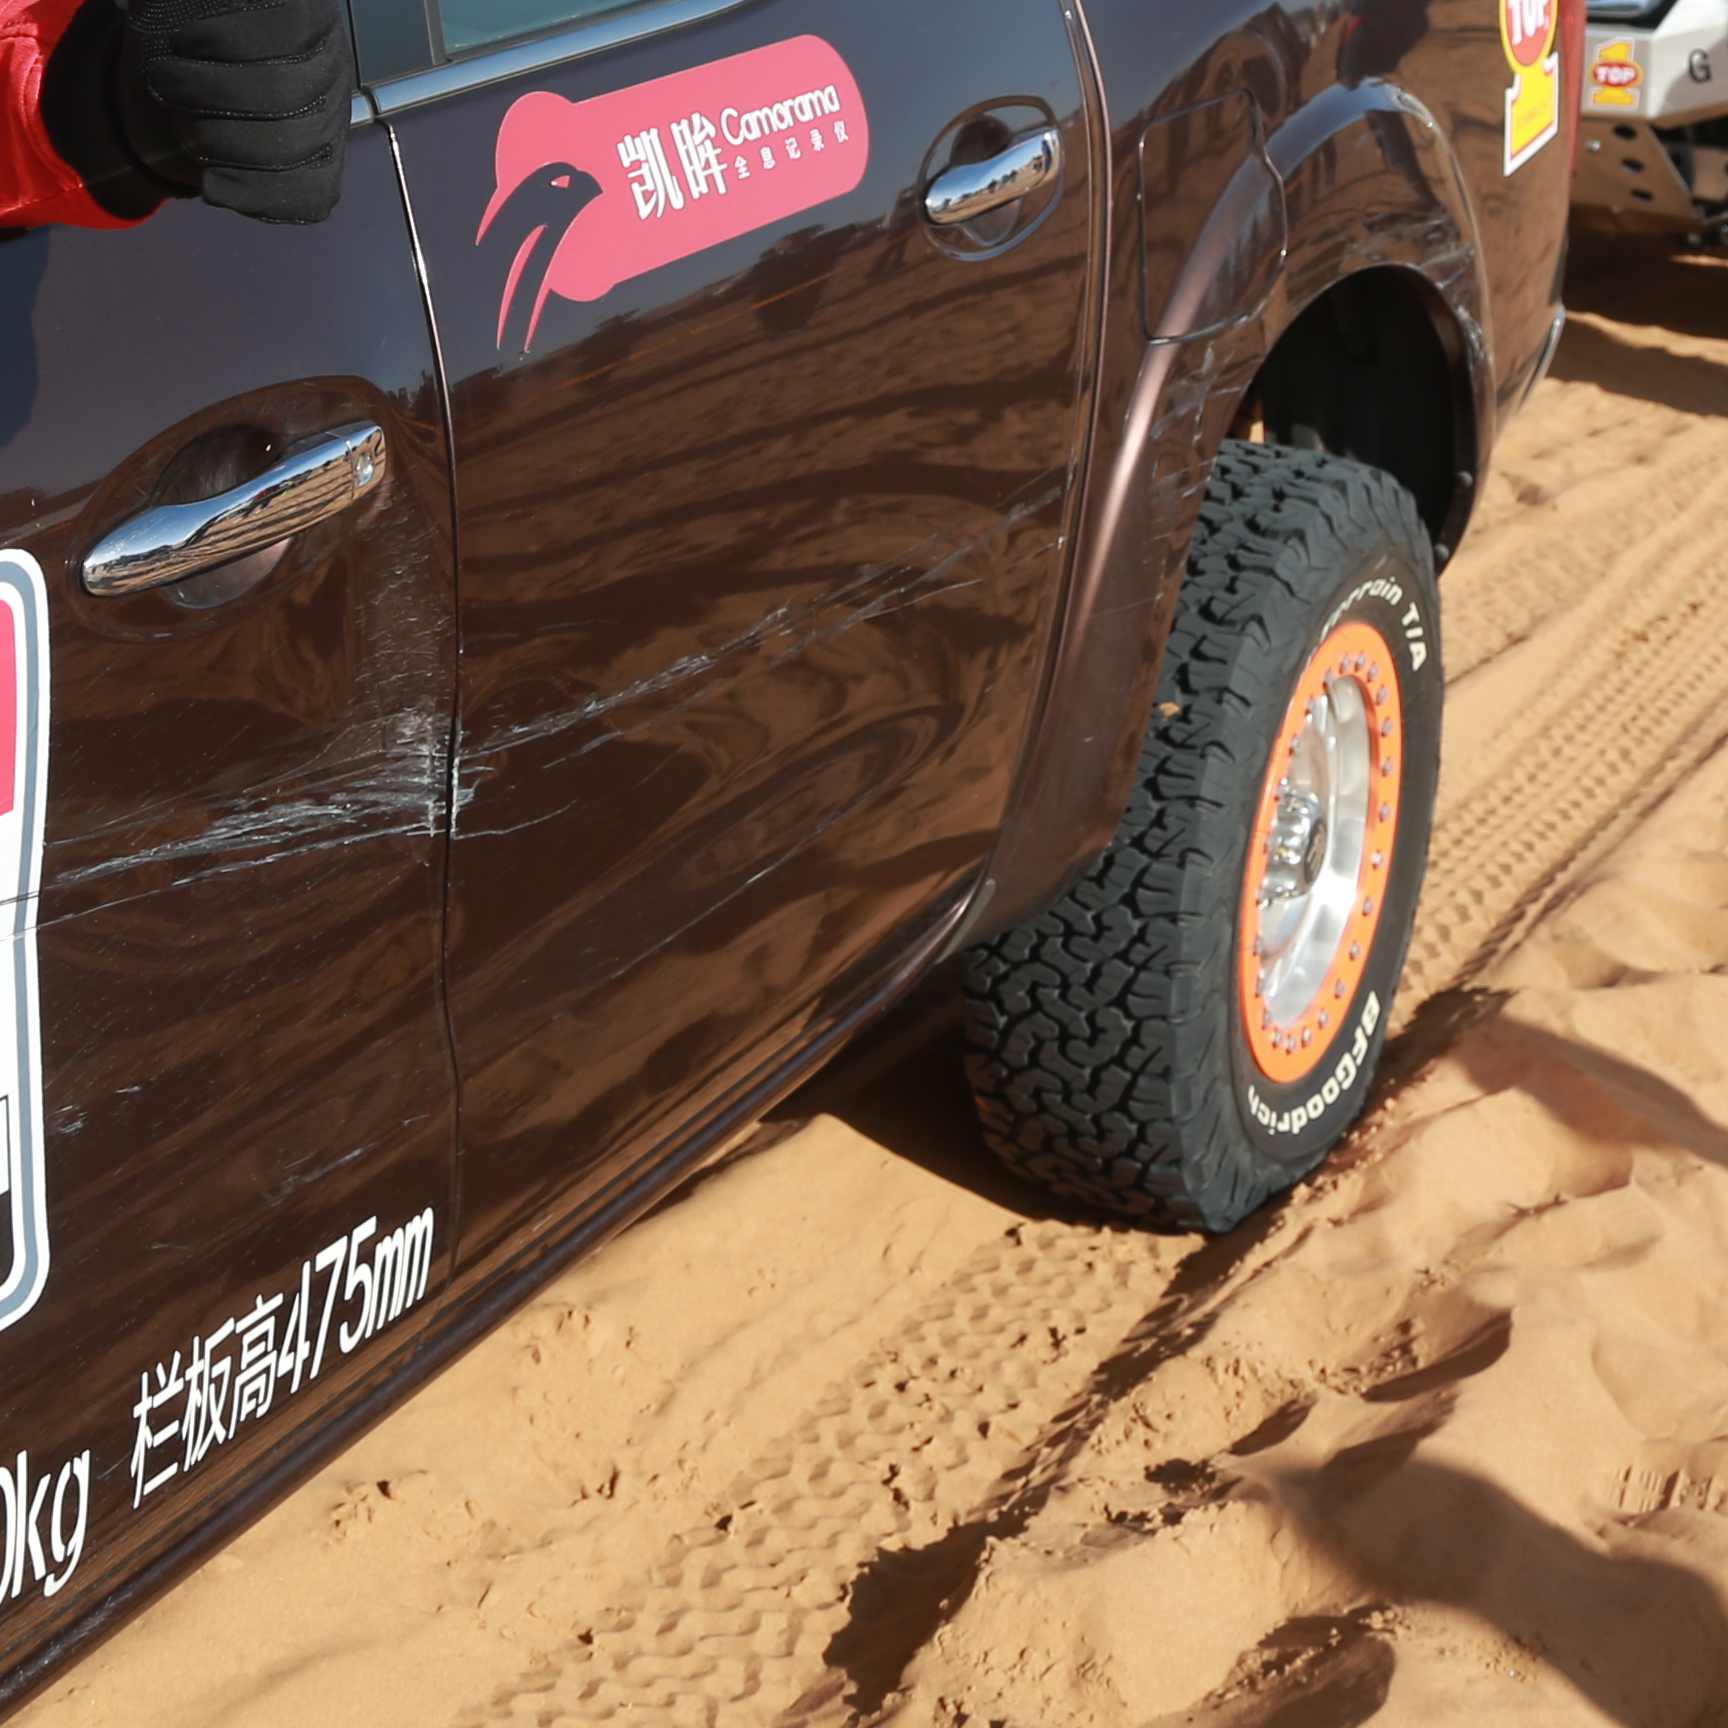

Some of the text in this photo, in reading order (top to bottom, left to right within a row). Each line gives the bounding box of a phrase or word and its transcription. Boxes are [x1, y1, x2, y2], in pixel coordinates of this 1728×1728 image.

[1595, 65, 1637, 85] TOP
[616, 84, 842, 221] 凯眸 Camorama
[734, 120, 849, 180] 全息记录仪
[1247, 989, 1382, 1136] BFGoodrich
[130, 1207, 435, 1510] 栏板高475mm
